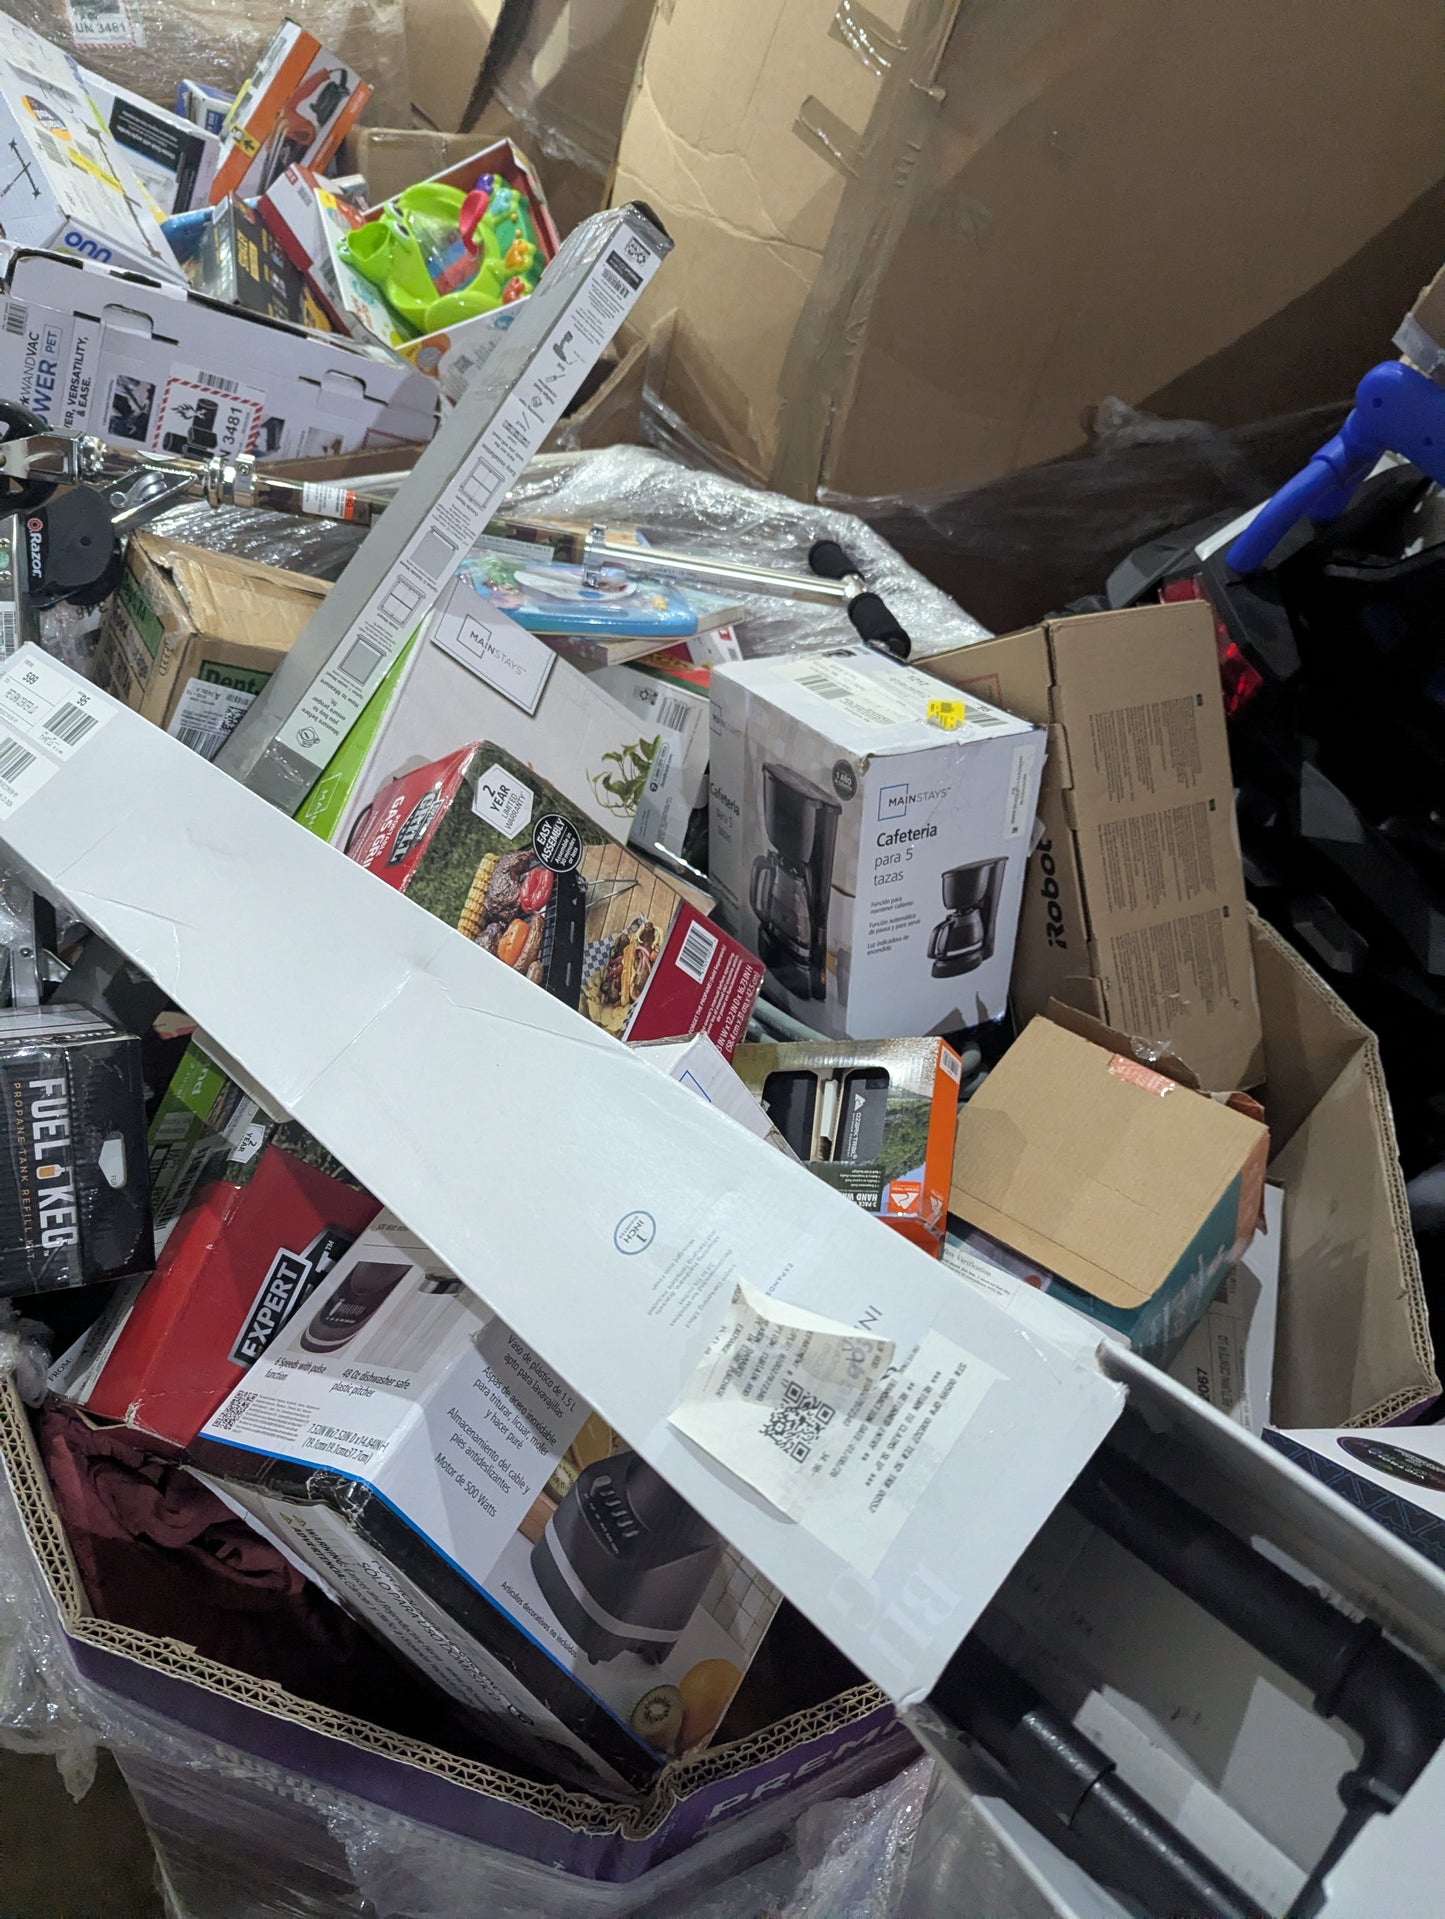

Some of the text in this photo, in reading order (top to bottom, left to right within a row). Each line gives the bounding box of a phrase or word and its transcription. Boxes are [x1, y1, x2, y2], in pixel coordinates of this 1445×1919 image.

[75, 21, 126, 33] UN 3481
[64, 230, 113, 263] onn
[25, 330, 60, 424] WER PET
[63, 335, 90, 406] VERSATILITY,
[76, 375, 92, 407] EASE.
[217, 406, 242, 461] N 3481
[481, 783, 497, 797] 2
[488, 783, 511, 812] YEAR
[378, 792, 405, 834] GAS
[499, 792, 520, 819] LIMITED
[534, 820, 555, 845] EASY
[536, 817, 570, 862] ASSEMBLY
[874, 822, 938, 847] Cafeteria
[552, 831, 573, 864] Assemble in
[567, 846, 579, 864] or less
[872, 847, 914, 870] para 5
[872, 869, 905, 886] tazas
[1039, 838, 1067, 949] iRobot
[742, 970, 751, 979] IN
[744, 964, 753, 972] H
[750, 971, 761, 984] cm)
[735, 977, 749, 995] 16.73
[744, 982, 758, 998] 42.5
[728, 1003, 739, 1013] IN
[732, 997, 740, 1005] D
[724, 1011, 736, 1025] 12.2
[730, 1022, 741, 1035] cm
[716, 1036, 726, 1045] IN
[718, 1028, 729, 1038] W
[723, 1034, 738, 1052] (58.4
[10, 1081, 27, 1143] PROPANE
[237, 1132, 253, 1152] YEAR
[17, 1149, 29, 1182] TANK
[25, 1077, 81, 1249] FUEL KEG
[856, 1192, 877, 1201] HAND
[19, 1189, 34, 1233] REFILL
[622, 1218, 644, 1244] INCH
[635, 1232, 647, 1243] 1
[954, 1254, 993, 1277] Verification
[239, 1260, 302, 1360] EXPERT
[264, 1367, 288, 1382] function
[279, 1355, 300, 1372] Speeds
[296, 1359, 312, 1372] with
[309, 1362, 327, 1377] pulse
[342, 1366, 411, 1390] 48 Oz dishwasher safe
[504, 1333, 578, 1413] Vaso de plástico de 1.5 L
[329, 1378, 376, 1401] plastic pitcher
[501, 1352, 569, 1419] apto para lavavajillas
[911, 1383, 933, 1412] RETURN
[471, 1377, 551, 1456] para triturar, licuar, moler
[479, 1365, 561, 1446] Aspas de acero inoxidable
[482, 1408, 527, 1451] y hacer puré
[441, 1405, 533, 1496] Almacenamiento del cable y
[448, 1430, 516, 1494] pies antideslizantes
[432, 1451, 501, 1518] Motor de 500 Watts
[521, 1601, 579, 1658] decorativos no incluidos
